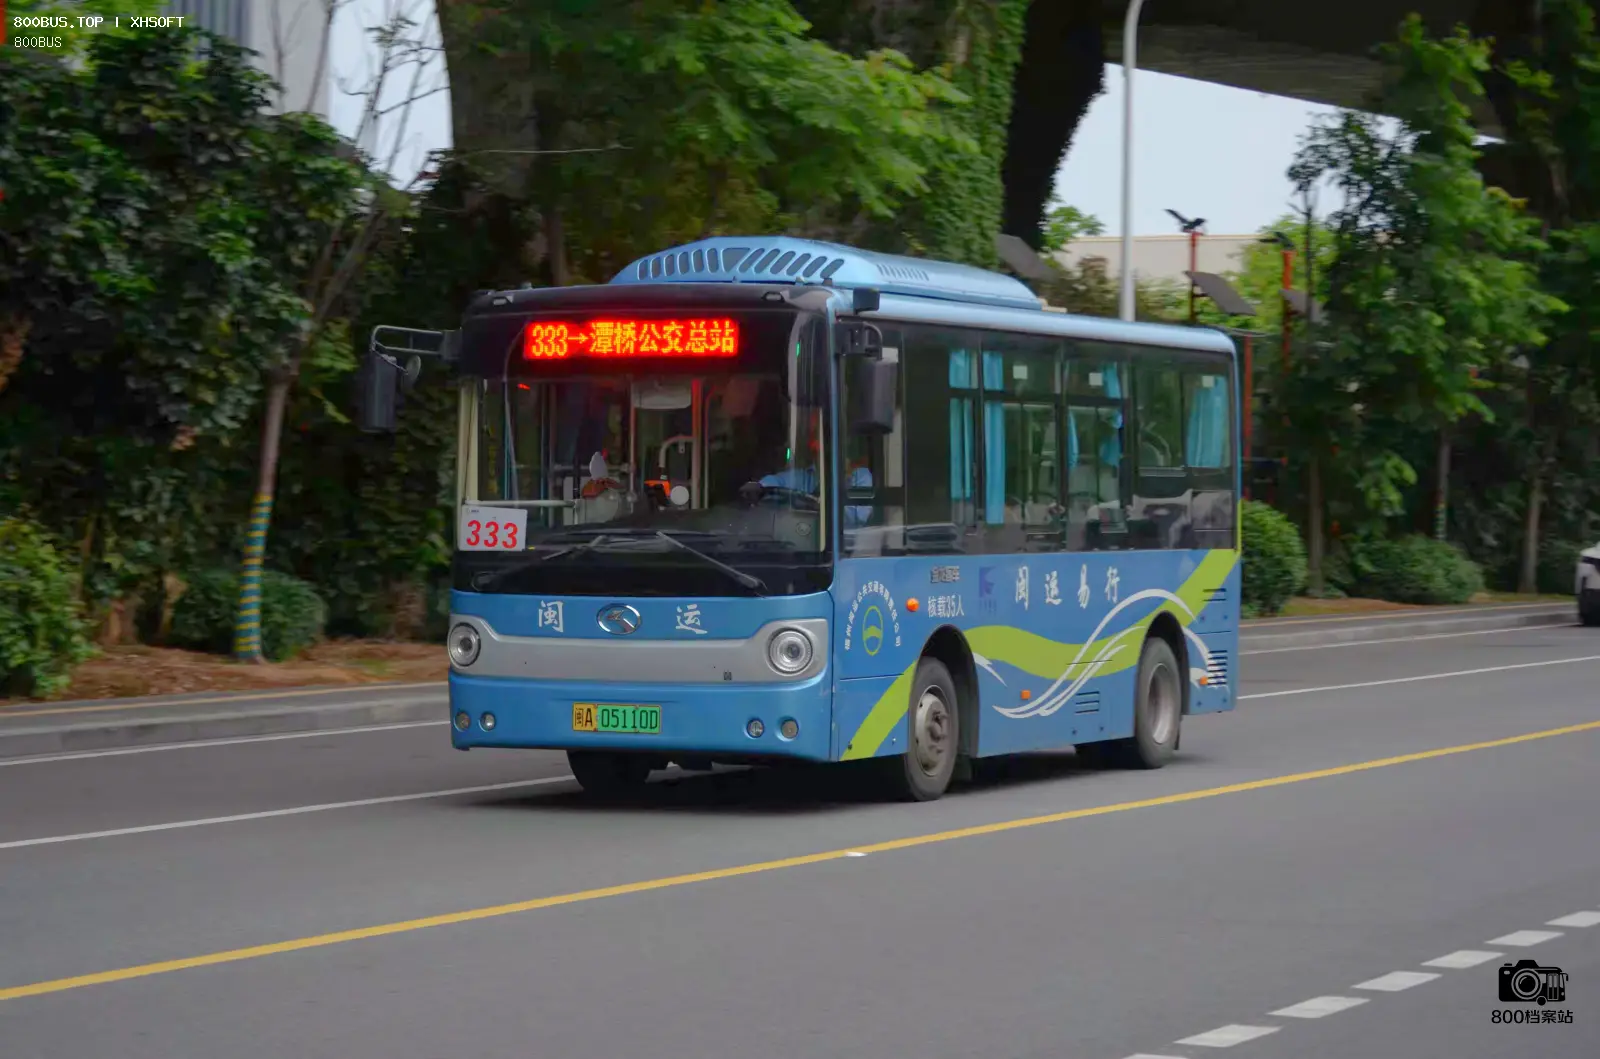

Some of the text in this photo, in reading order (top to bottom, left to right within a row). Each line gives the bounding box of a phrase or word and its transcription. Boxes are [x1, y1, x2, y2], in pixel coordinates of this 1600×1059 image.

[531, 320, 735, 356] 333 潭桥公交总站
[466, 519, 519, 549] 333
[538, 600, 708, 635] 闽 运
[927, 594, 965, 619] 核载35人
[600, 708, 659, 730] 05110D
